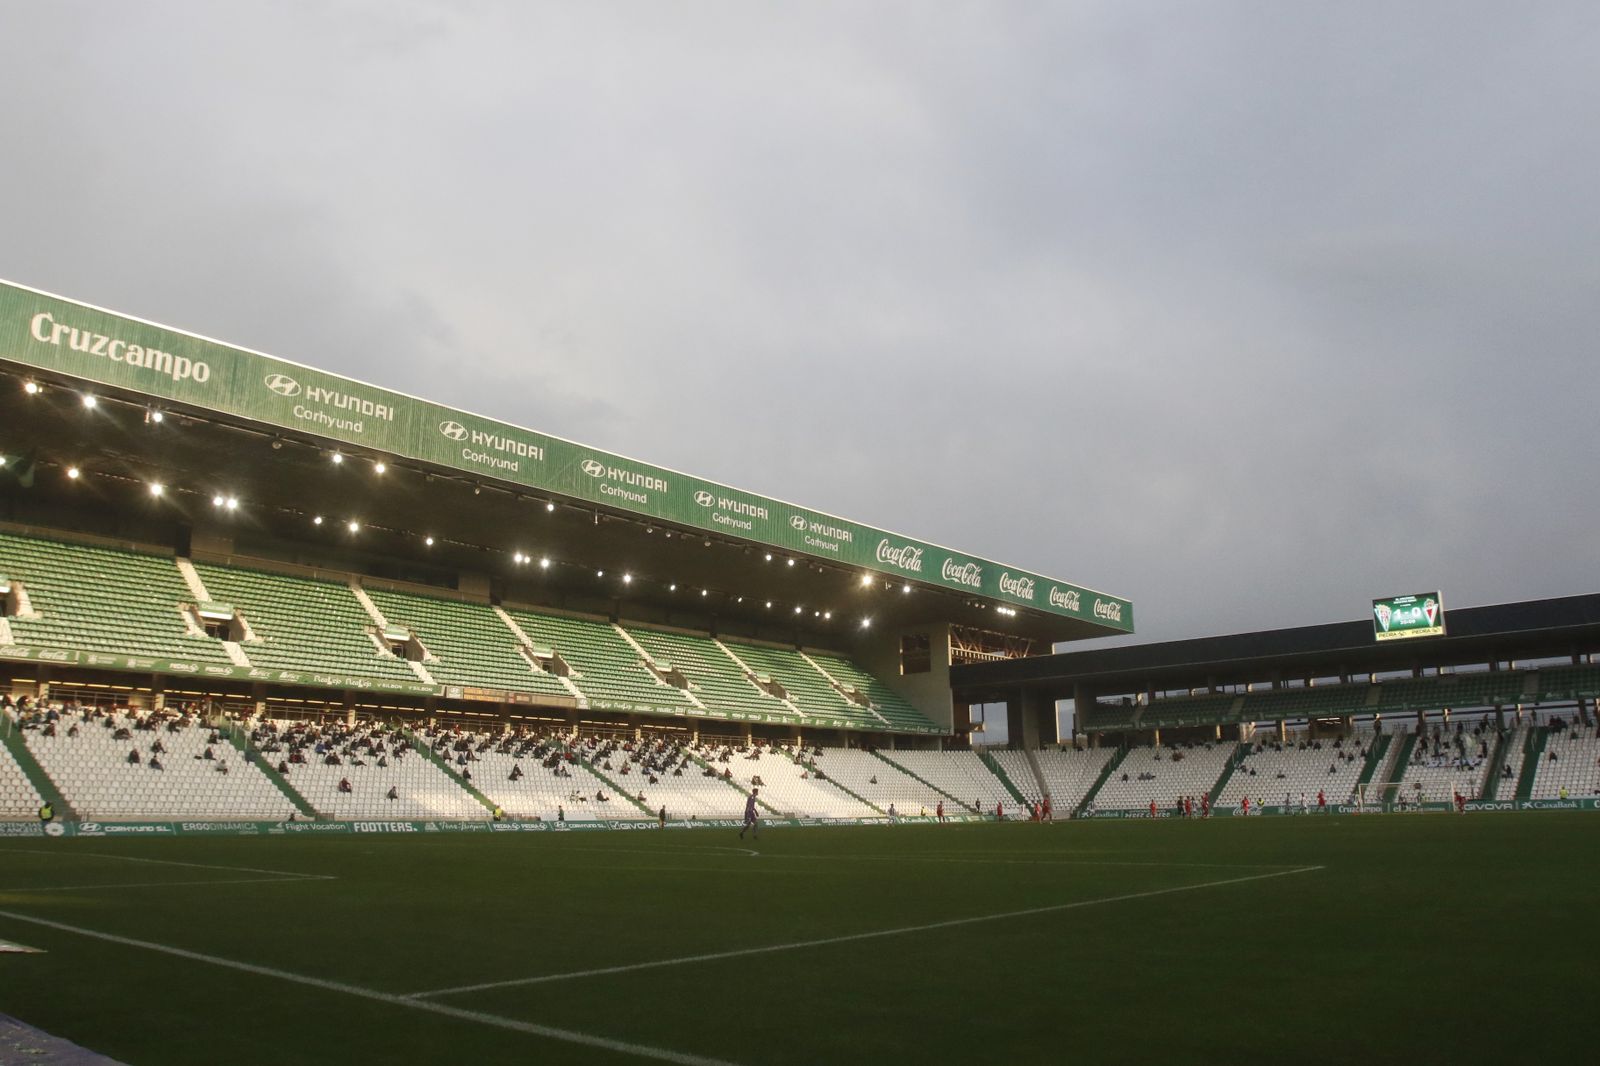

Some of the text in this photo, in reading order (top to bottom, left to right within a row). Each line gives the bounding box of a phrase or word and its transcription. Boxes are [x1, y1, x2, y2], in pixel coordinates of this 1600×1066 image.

[31, 312, 210, 383] Cruzcampo
[306, 385, 393, 422] HYUNDAI
[293, 405, 363, 433] Corhyund
[471, 430, 543, 461] HYUNDAI
[462, 448, 519, 472] Corhyund
[607, 467, 668, 493] HYUNDAI
[600, 483, 647, 504] Corhyund
[718, 497, 768, 520] HYUNDAI
[712, 512, 752, 530] Corhyund
[804, 535, 839, 552] Corhyund
[809, 522, 853, 543] HYUNDAI
[1464, 803, 1512, 811] GIVOVA
[1533, 801, 1578, 809] CaixaBank
[285, 822, 312, 832] Flight
[312, 822, 346, 831] Vocation
